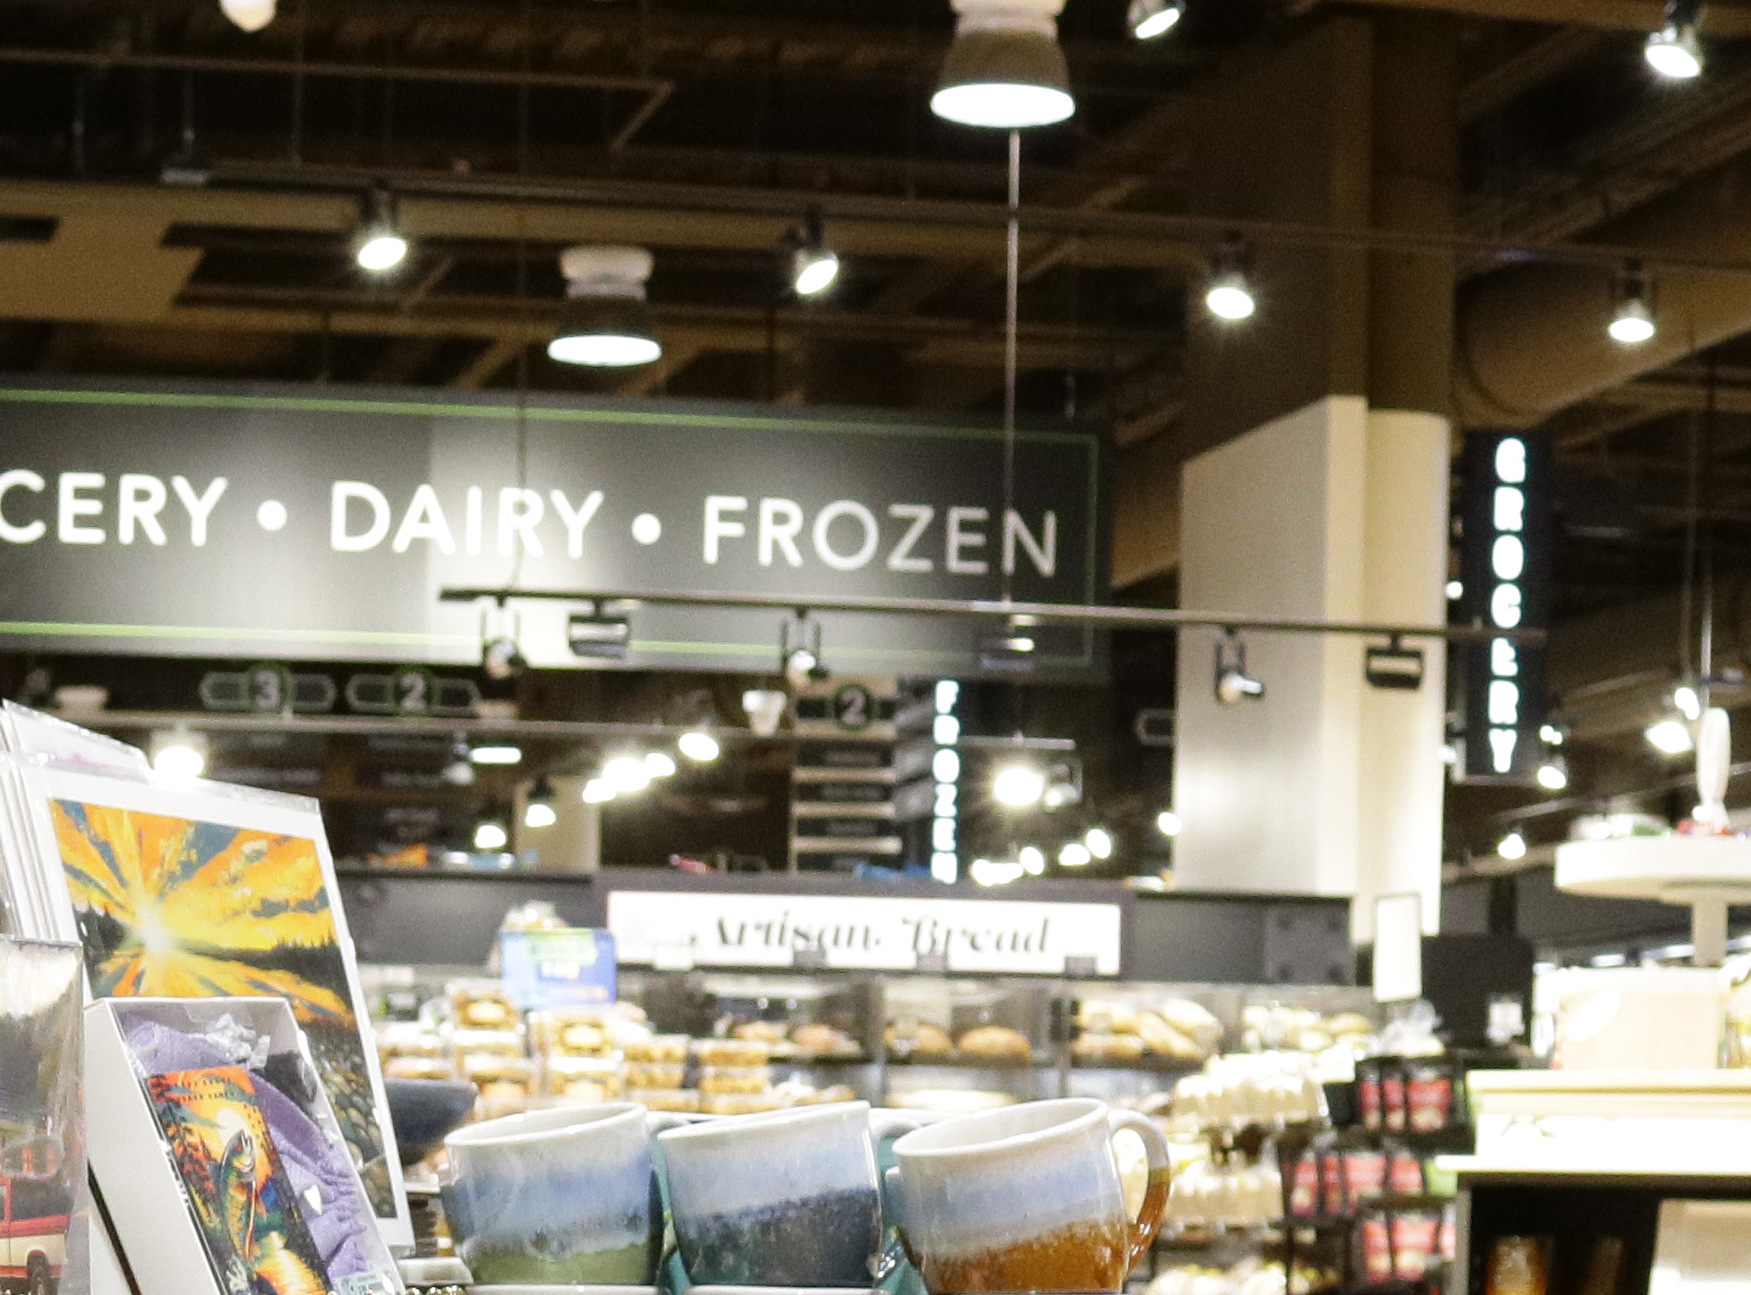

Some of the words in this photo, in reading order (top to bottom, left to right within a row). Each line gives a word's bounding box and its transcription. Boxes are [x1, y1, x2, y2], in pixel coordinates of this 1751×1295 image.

[328, 478, 605, 561] DAIRY
[701, 493, 1060, 578] FROZEN
[690, 911, 882, 953] Artisan
[904, 912, 1055, 957] Bread
